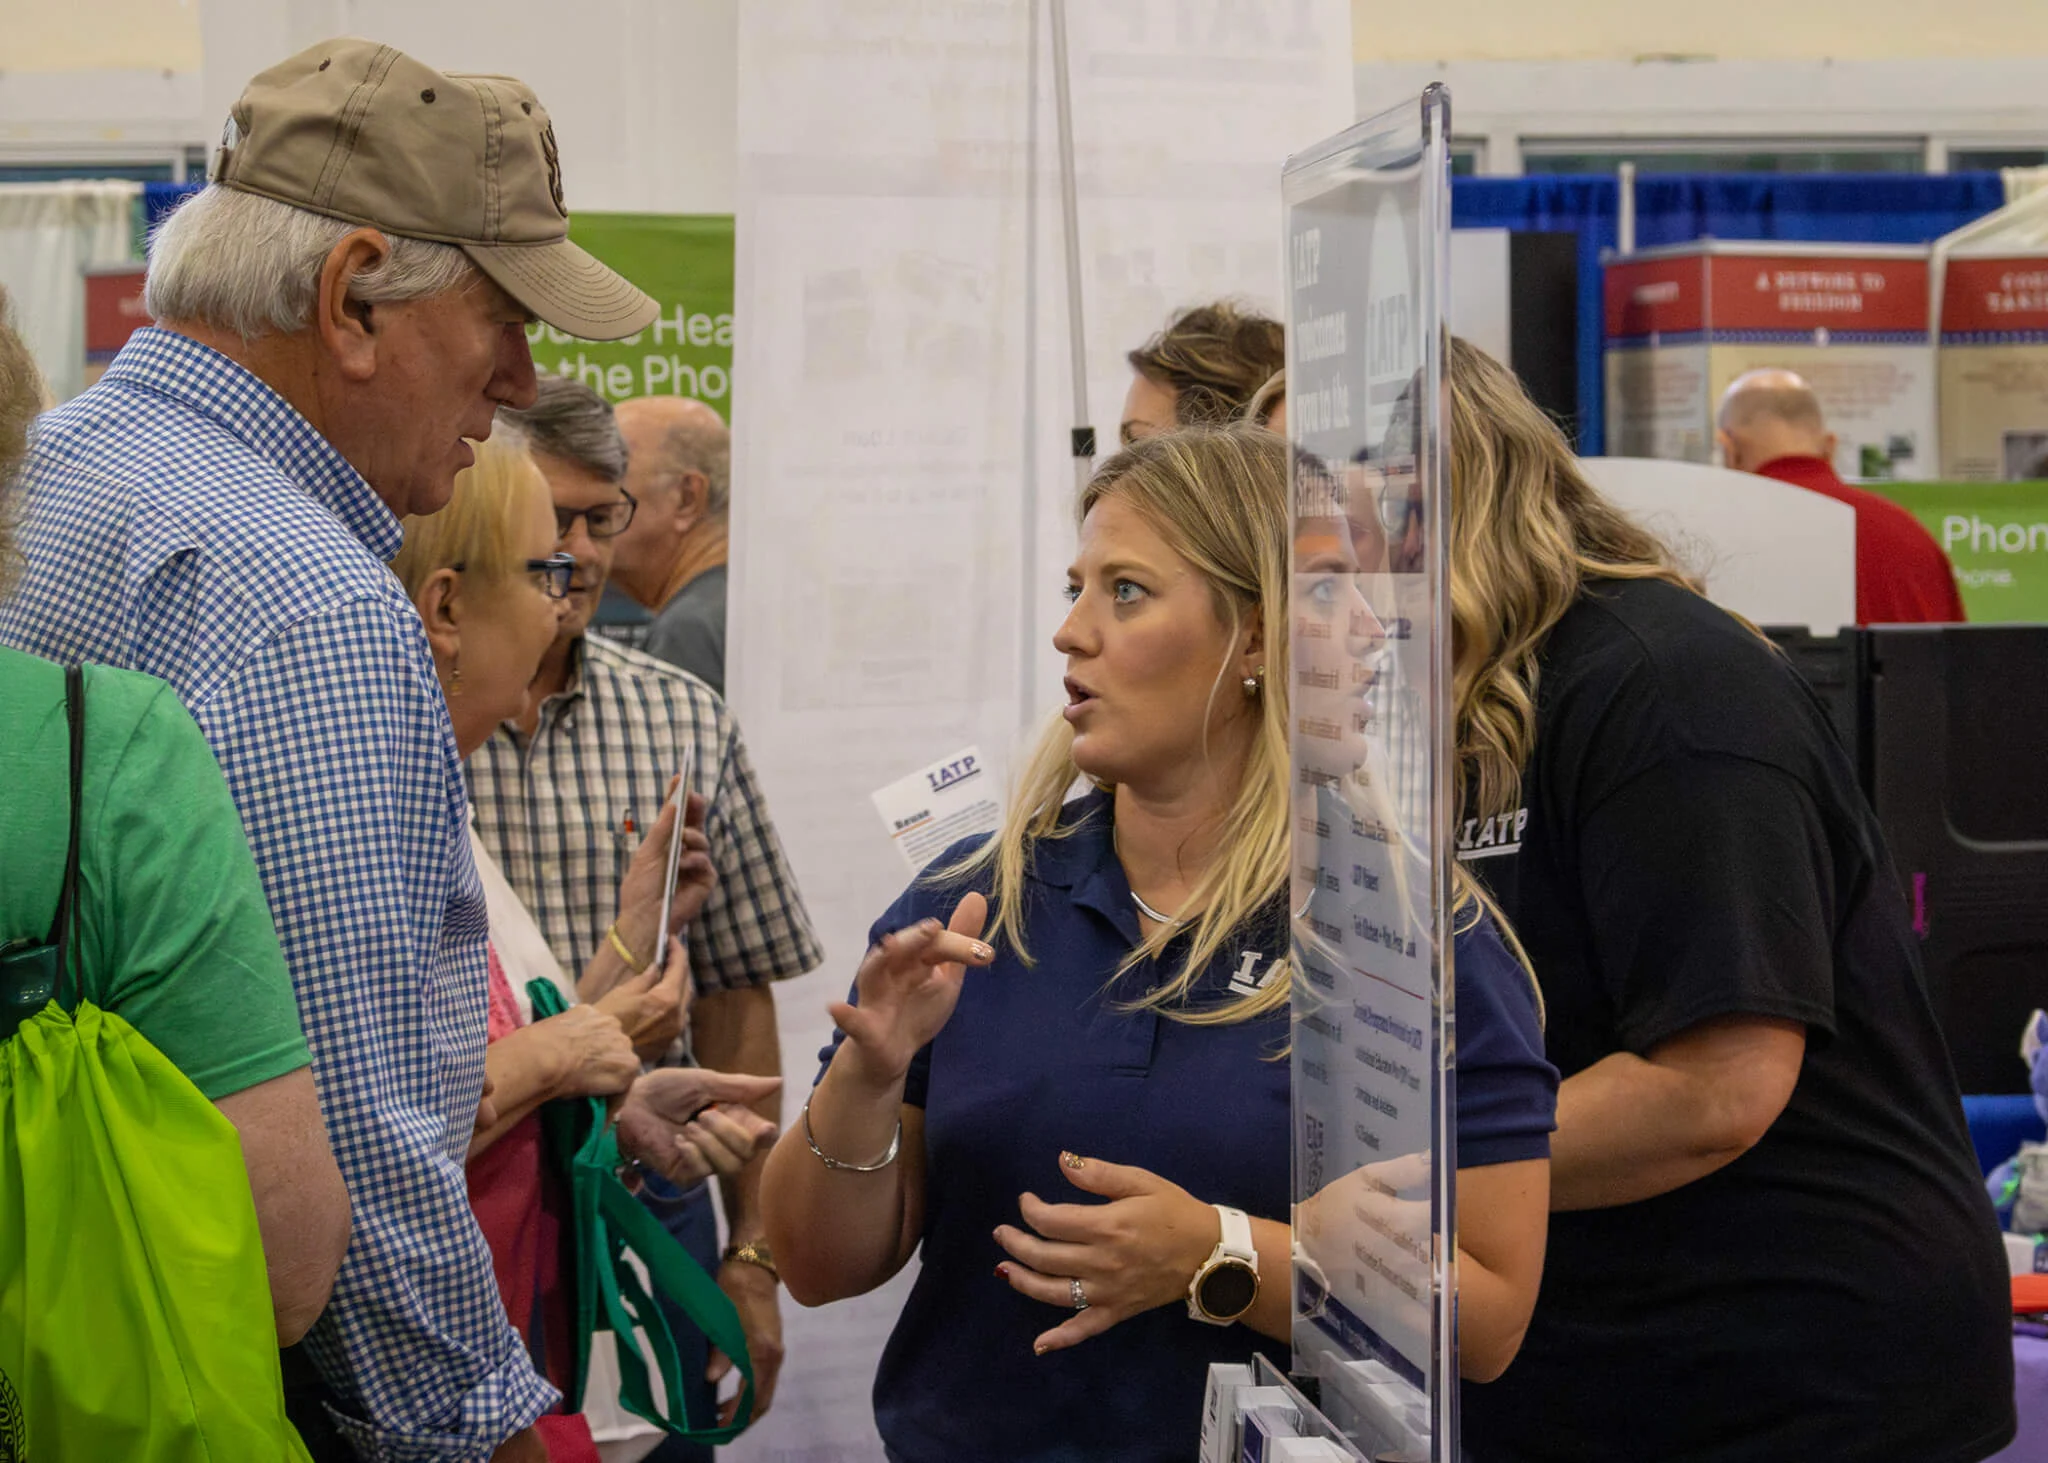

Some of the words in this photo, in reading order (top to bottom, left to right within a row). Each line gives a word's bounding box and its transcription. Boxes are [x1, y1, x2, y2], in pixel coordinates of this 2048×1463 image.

[1293, 227, 1321, 290] IATP
[643, 354, 733, 398] Pho
[1296, 391, 1318, 444] you
[1319, 383, 1330, 430] to
[1332, 371, 1350, 429] the
[927, 755, 976, 787] IATP
[1459, 808, 1528, 849] IATP
